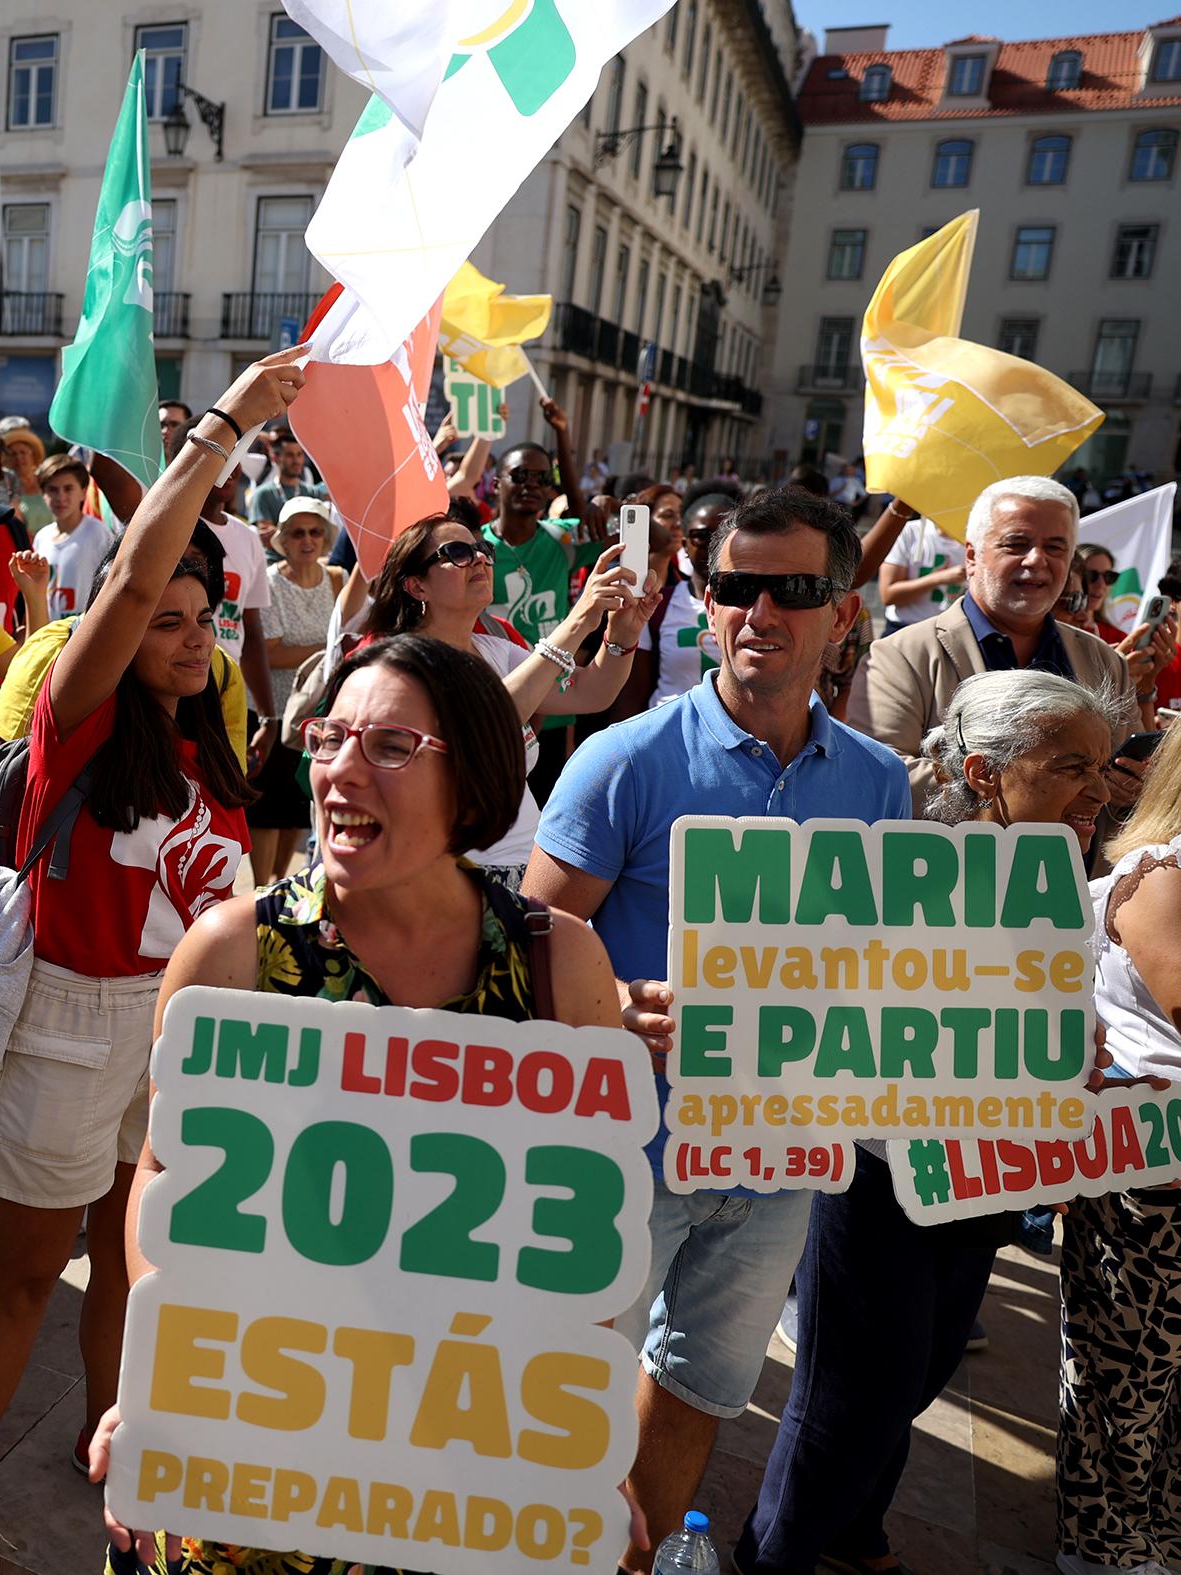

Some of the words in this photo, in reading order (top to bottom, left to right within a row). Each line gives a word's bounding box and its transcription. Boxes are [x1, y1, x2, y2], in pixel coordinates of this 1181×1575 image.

[684, 828, 1085, 929] MARIA
[181, 1016, 321, 1087] JMJ
[341, 1032, 632, 1121] LISBOA
[680, 1005, 733, 1077] E
[758, 1006, 1084, 1080] PARTIU
[678, 1084, 1085, 1136] apressadamente
[169, 1107, 625, 1295] 2023
[676, 1142, 732, 1181] (LC
[743, 1146, 775, 1181] 1,
[788, 1142, 844, 1182] 39)
[150, 1304, 611, 1470] ESTÁS
[137, 1449, 603, 1565] PREPARADO?
